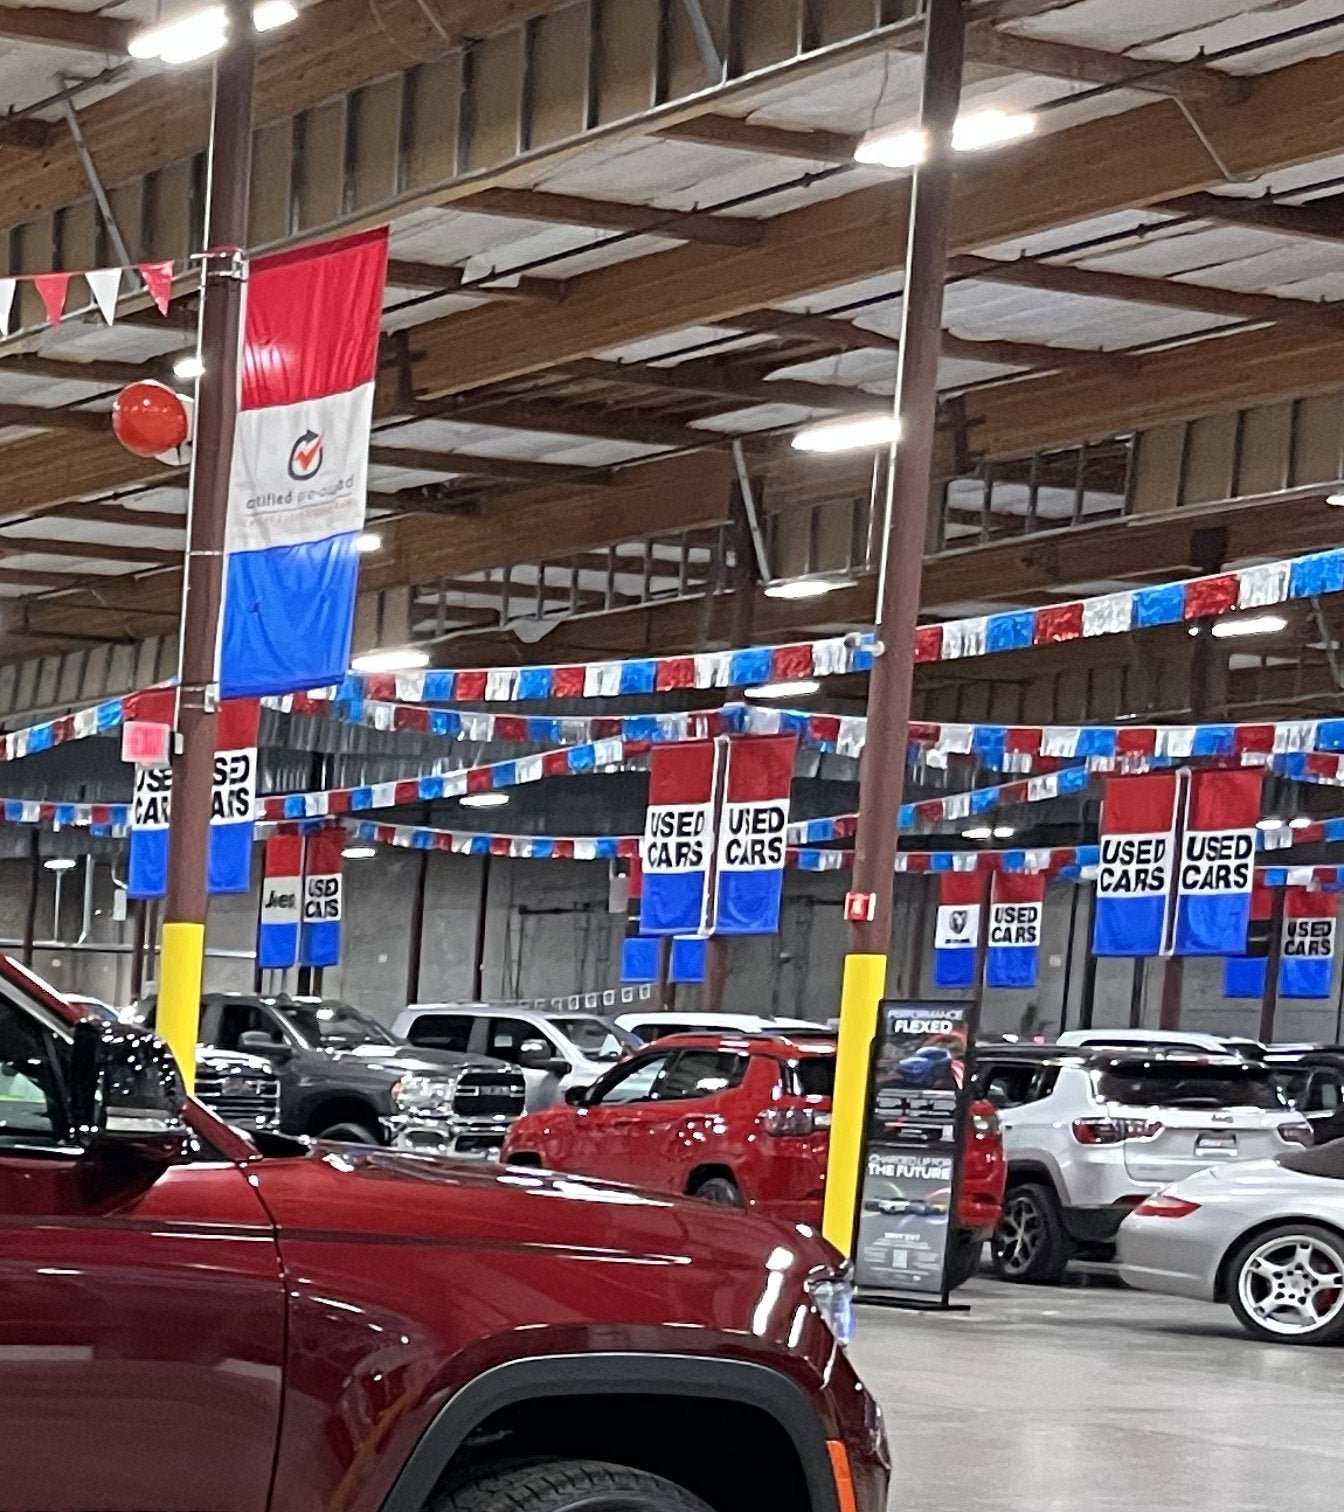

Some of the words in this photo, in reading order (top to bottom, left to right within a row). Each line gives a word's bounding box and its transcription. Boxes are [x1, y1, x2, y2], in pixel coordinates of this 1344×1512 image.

[214, 754, 250, 786] SED
[134, 796, 170, 825] CAR
[212, 787, 250, 818] ARS
[651, 810, 706, 838] USED
[728, 806, 786, 836] USED
[647, 840, 704, 868] CARS
[725, 836, 784, 866] CARS
[1101, 838, 1167, 866] USED
[1185, 834, 1254, 862] USED
[1099, 866, 1166, 893] CARS
[1181, 862, 1250, 890] CARS
[994, 906, 1039, 924] USED
[1287, 920, 1332, 938] USED
[991, 925, 1037, 944] CARS
[1284, 938, 1332, 956] CARS
[894, 1019, 953, 1034] FLEXED
[868, 1162, 895, 1177] THE
[895, 1165, 951, 1180] FUTURE
